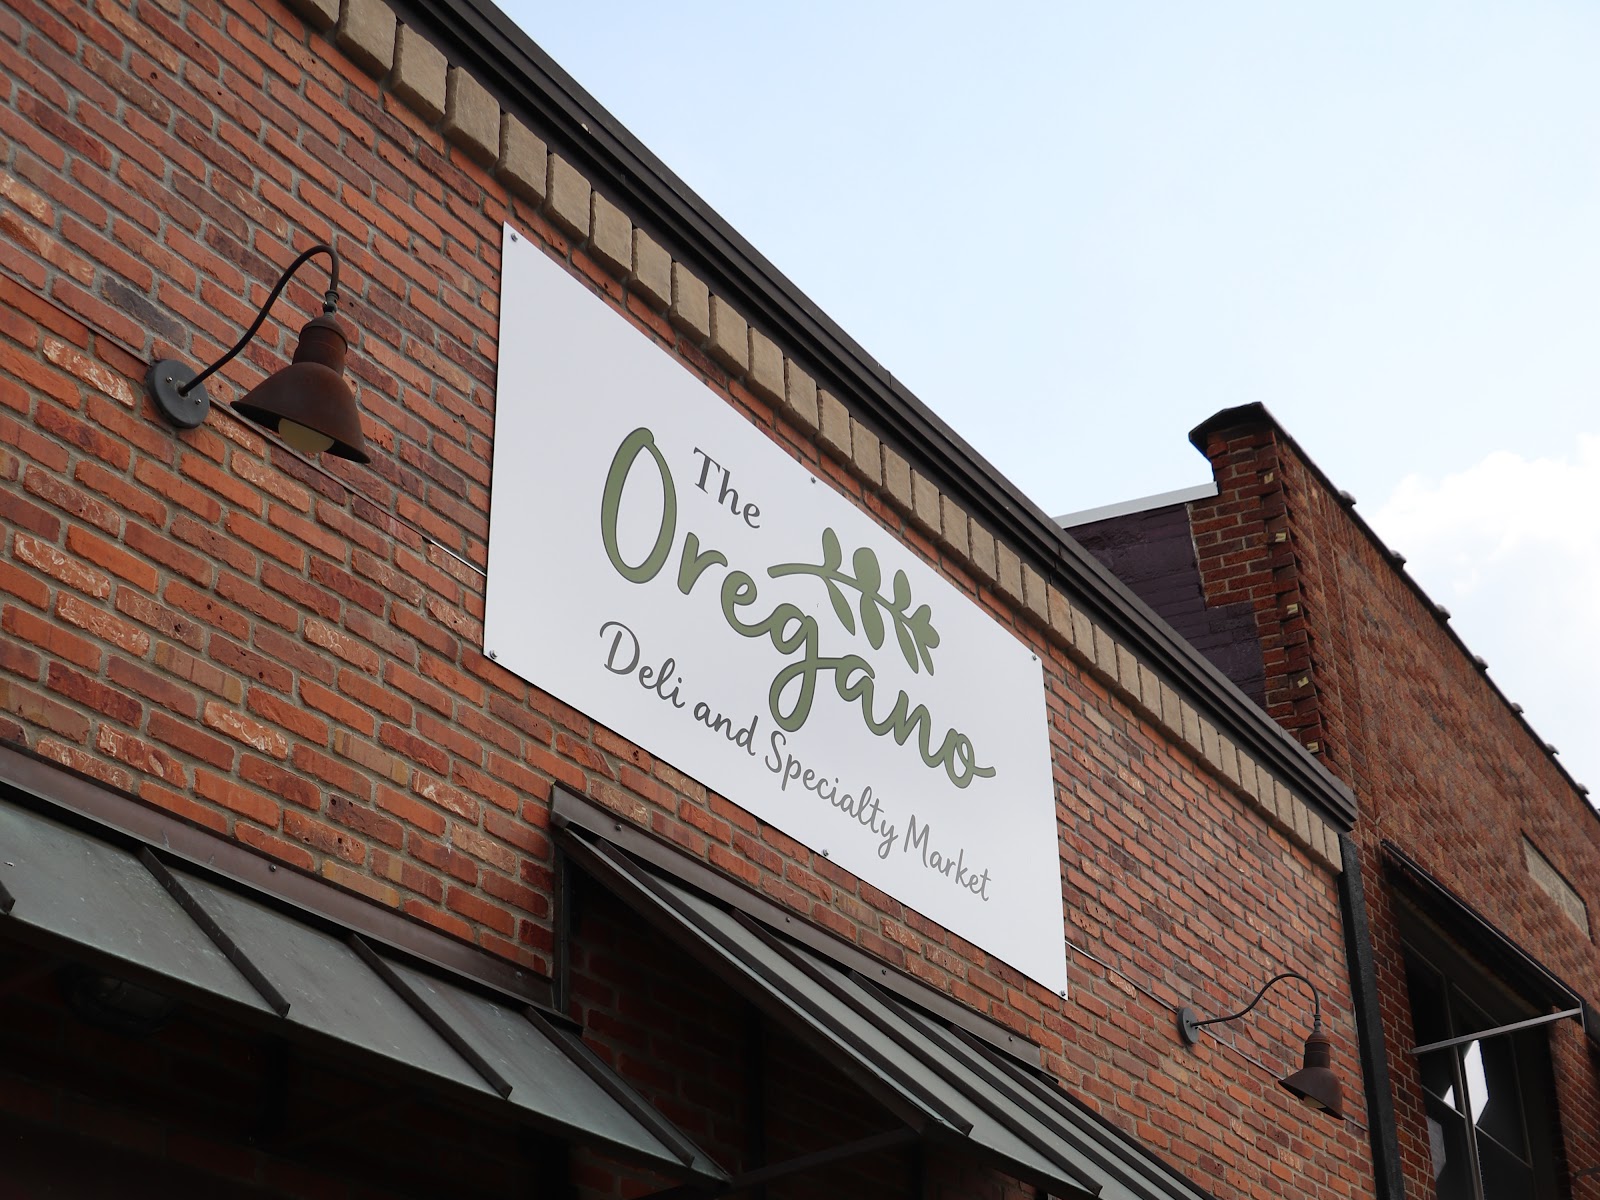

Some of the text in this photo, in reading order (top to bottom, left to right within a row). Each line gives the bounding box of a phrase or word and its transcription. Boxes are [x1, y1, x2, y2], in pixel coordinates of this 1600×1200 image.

[601, 427, 996, 788] Oregano
[693, 447, 762, 529] The
[599, 621, 992, 901] Deli and Specialty Market
